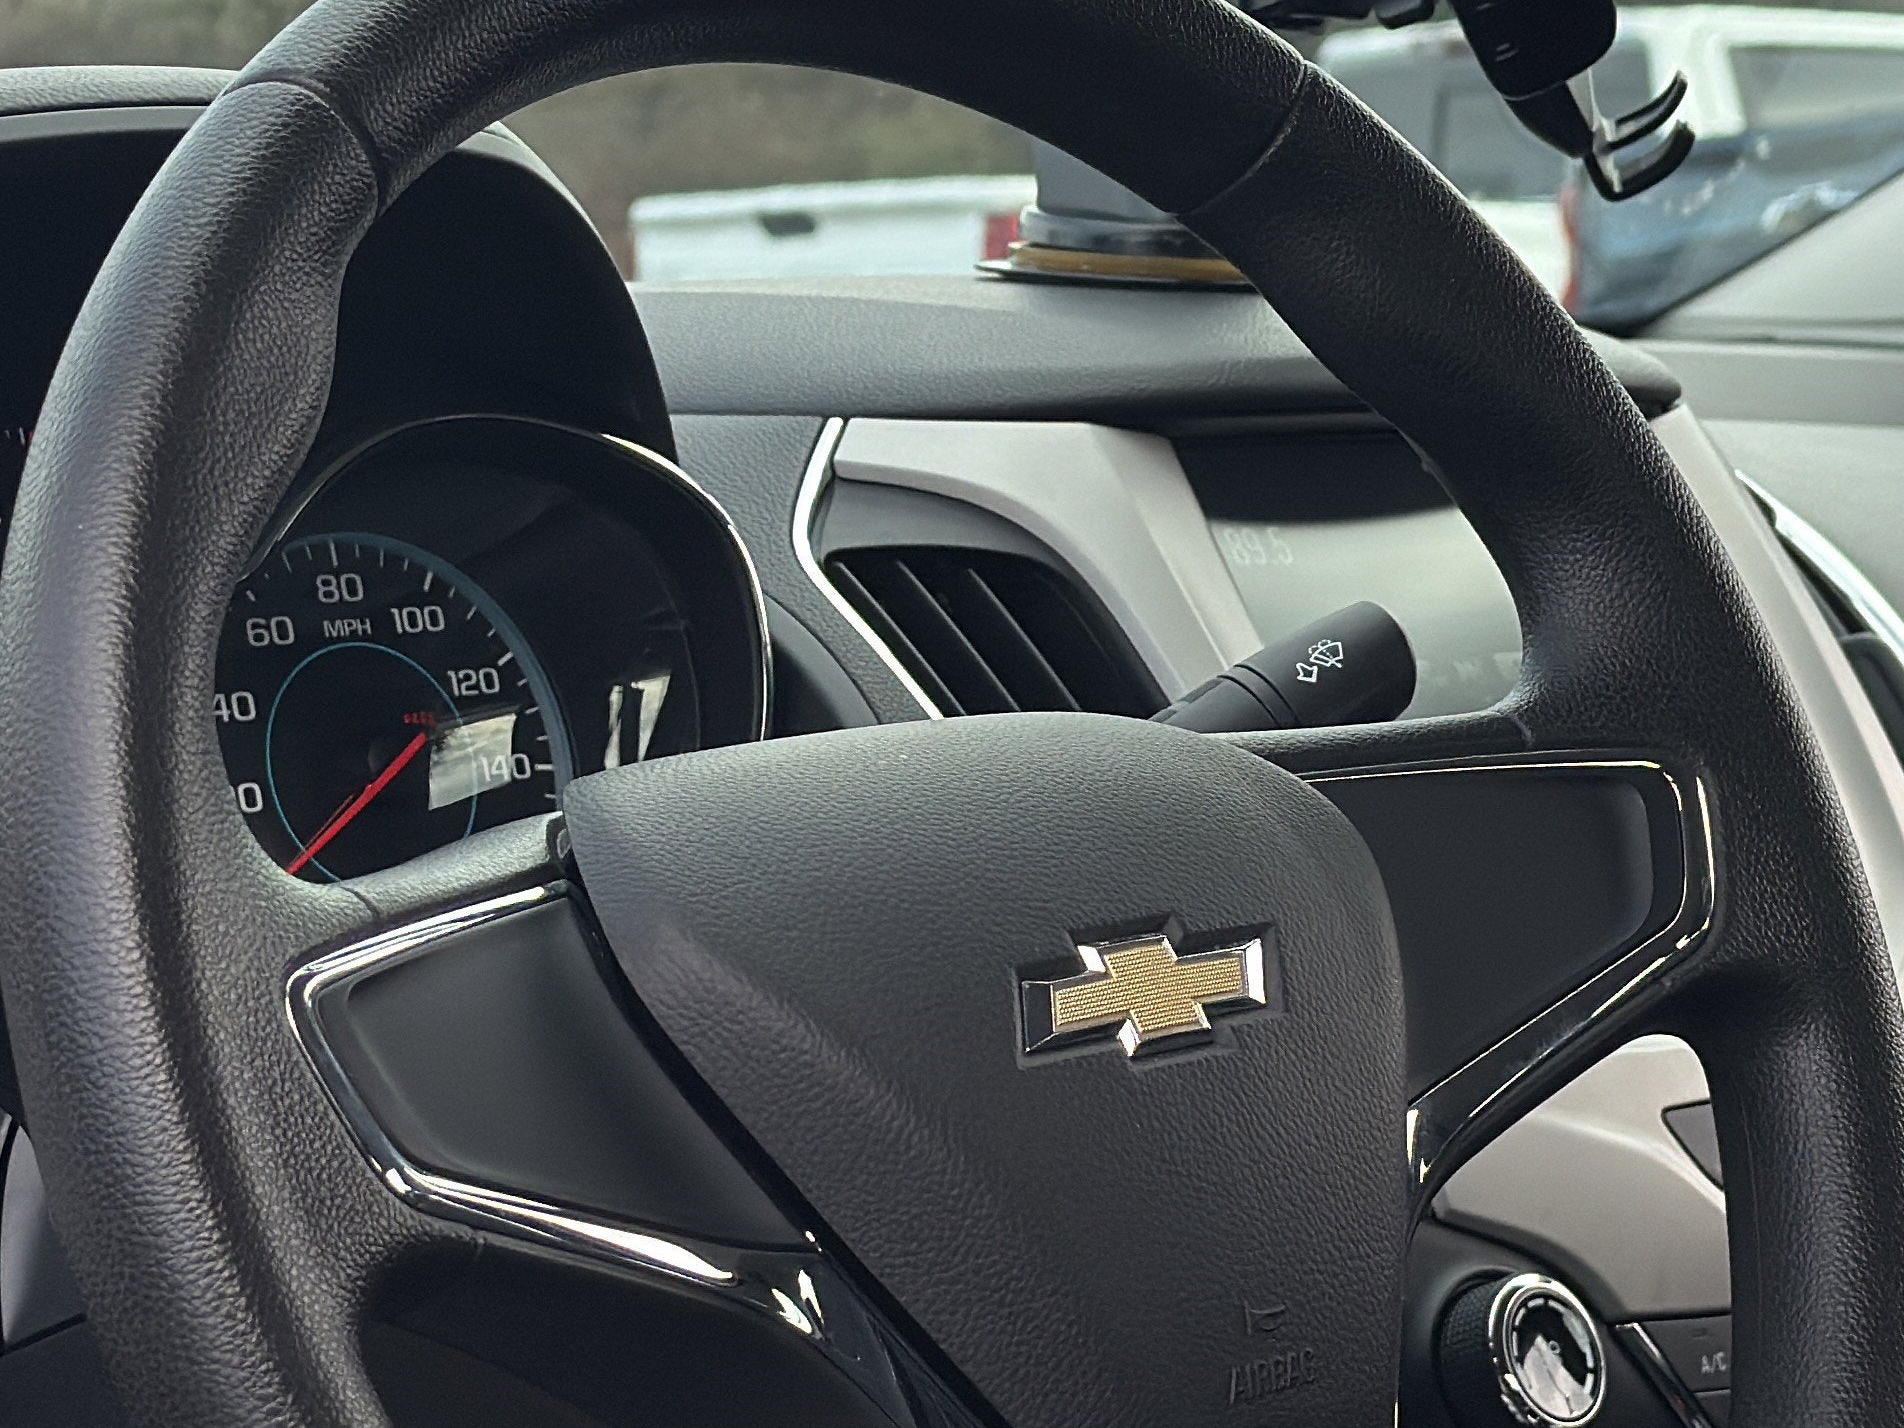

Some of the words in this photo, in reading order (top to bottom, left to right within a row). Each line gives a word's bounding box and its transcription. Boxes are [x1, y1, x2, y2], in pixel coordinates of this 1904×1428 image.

[316, 573, 363, 603] 80
[246, 616, 295, 646] 60
[323, 619, 371, 638] MPH
[391, 606, 445, 634] 100
[448, 668, 500, 697] 120
[210, 691, 256, 722] 40
[479, 754, 531, 782] 140
